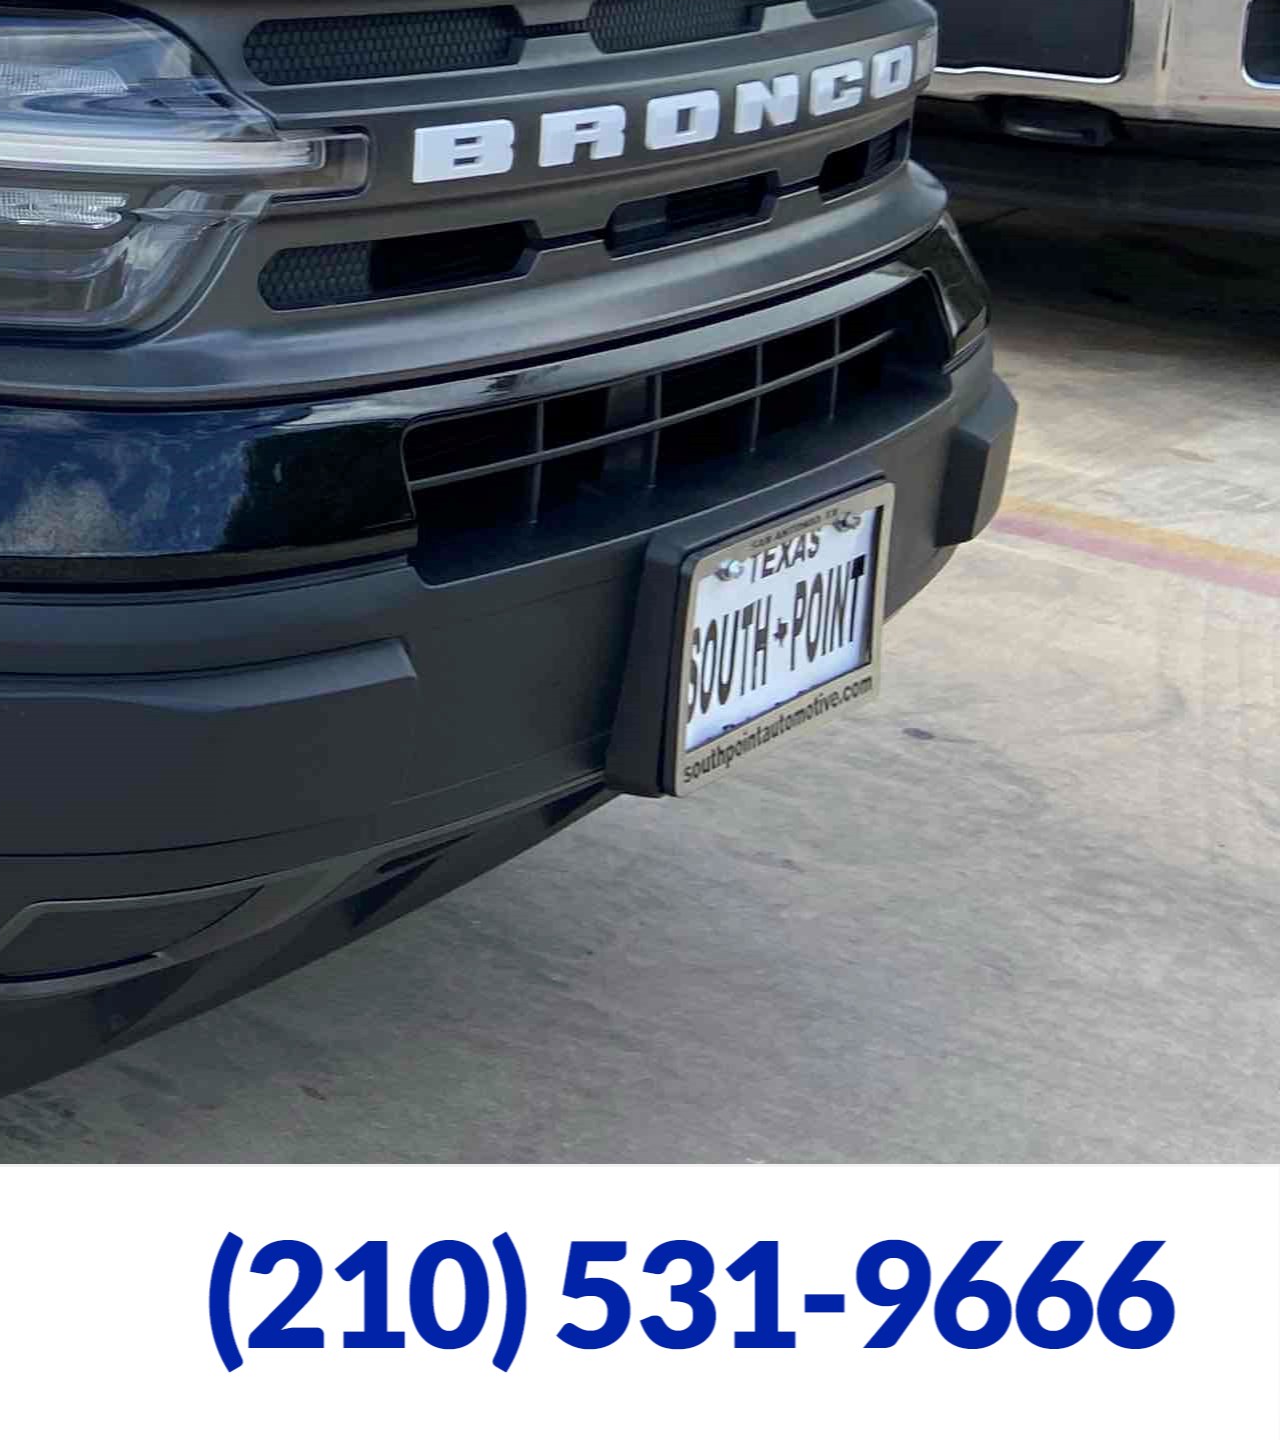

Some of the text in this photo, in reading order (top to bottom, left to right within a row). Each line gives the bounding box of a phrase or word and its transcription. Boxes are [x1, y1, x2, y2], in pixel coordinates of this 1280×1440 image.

[412, 45, 914, 186] BRONCO
[751, 535, 822, 583] TEXAS
[686, 553, 866, 724] SOUTH POINT
[683, 674, 874, 784] southpointautomotive.com
